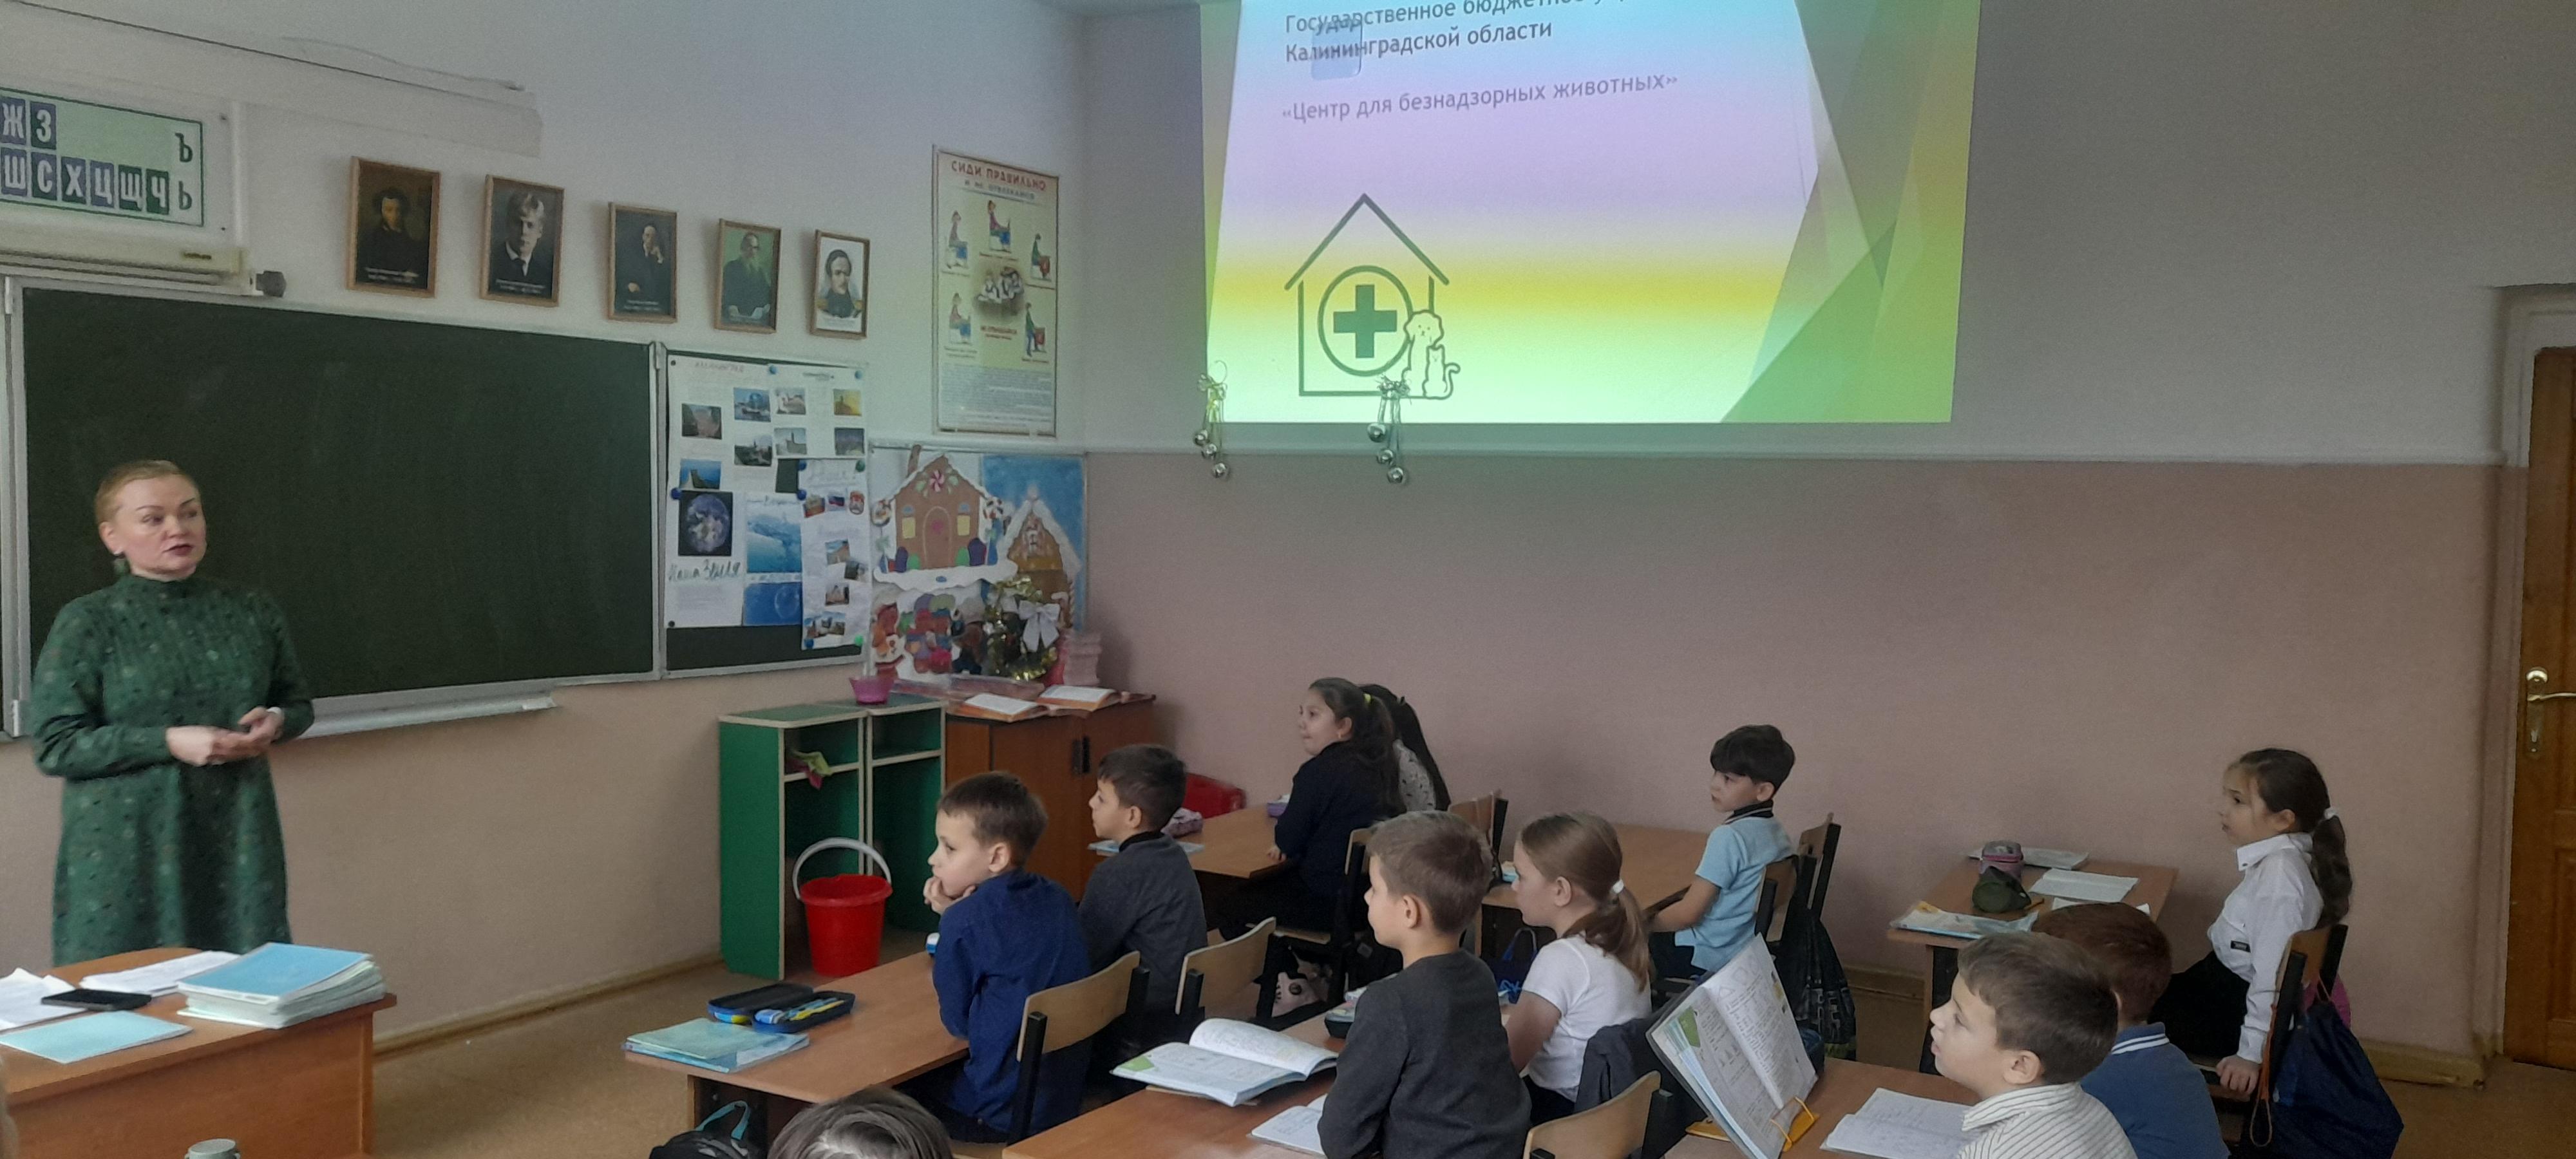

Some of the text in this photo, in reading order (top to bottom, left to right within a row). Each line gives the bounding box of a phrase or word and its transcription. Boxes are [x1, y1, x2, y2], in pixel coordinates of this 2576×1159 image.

[1286, 2, 1455, 35] Государственное
[1286, 23, 1552, 62] Калининградской области
[1283, 74, 1678, 123] «Центр для безнадзорных животных»
[951, 161, 981, 176] СИДИ
